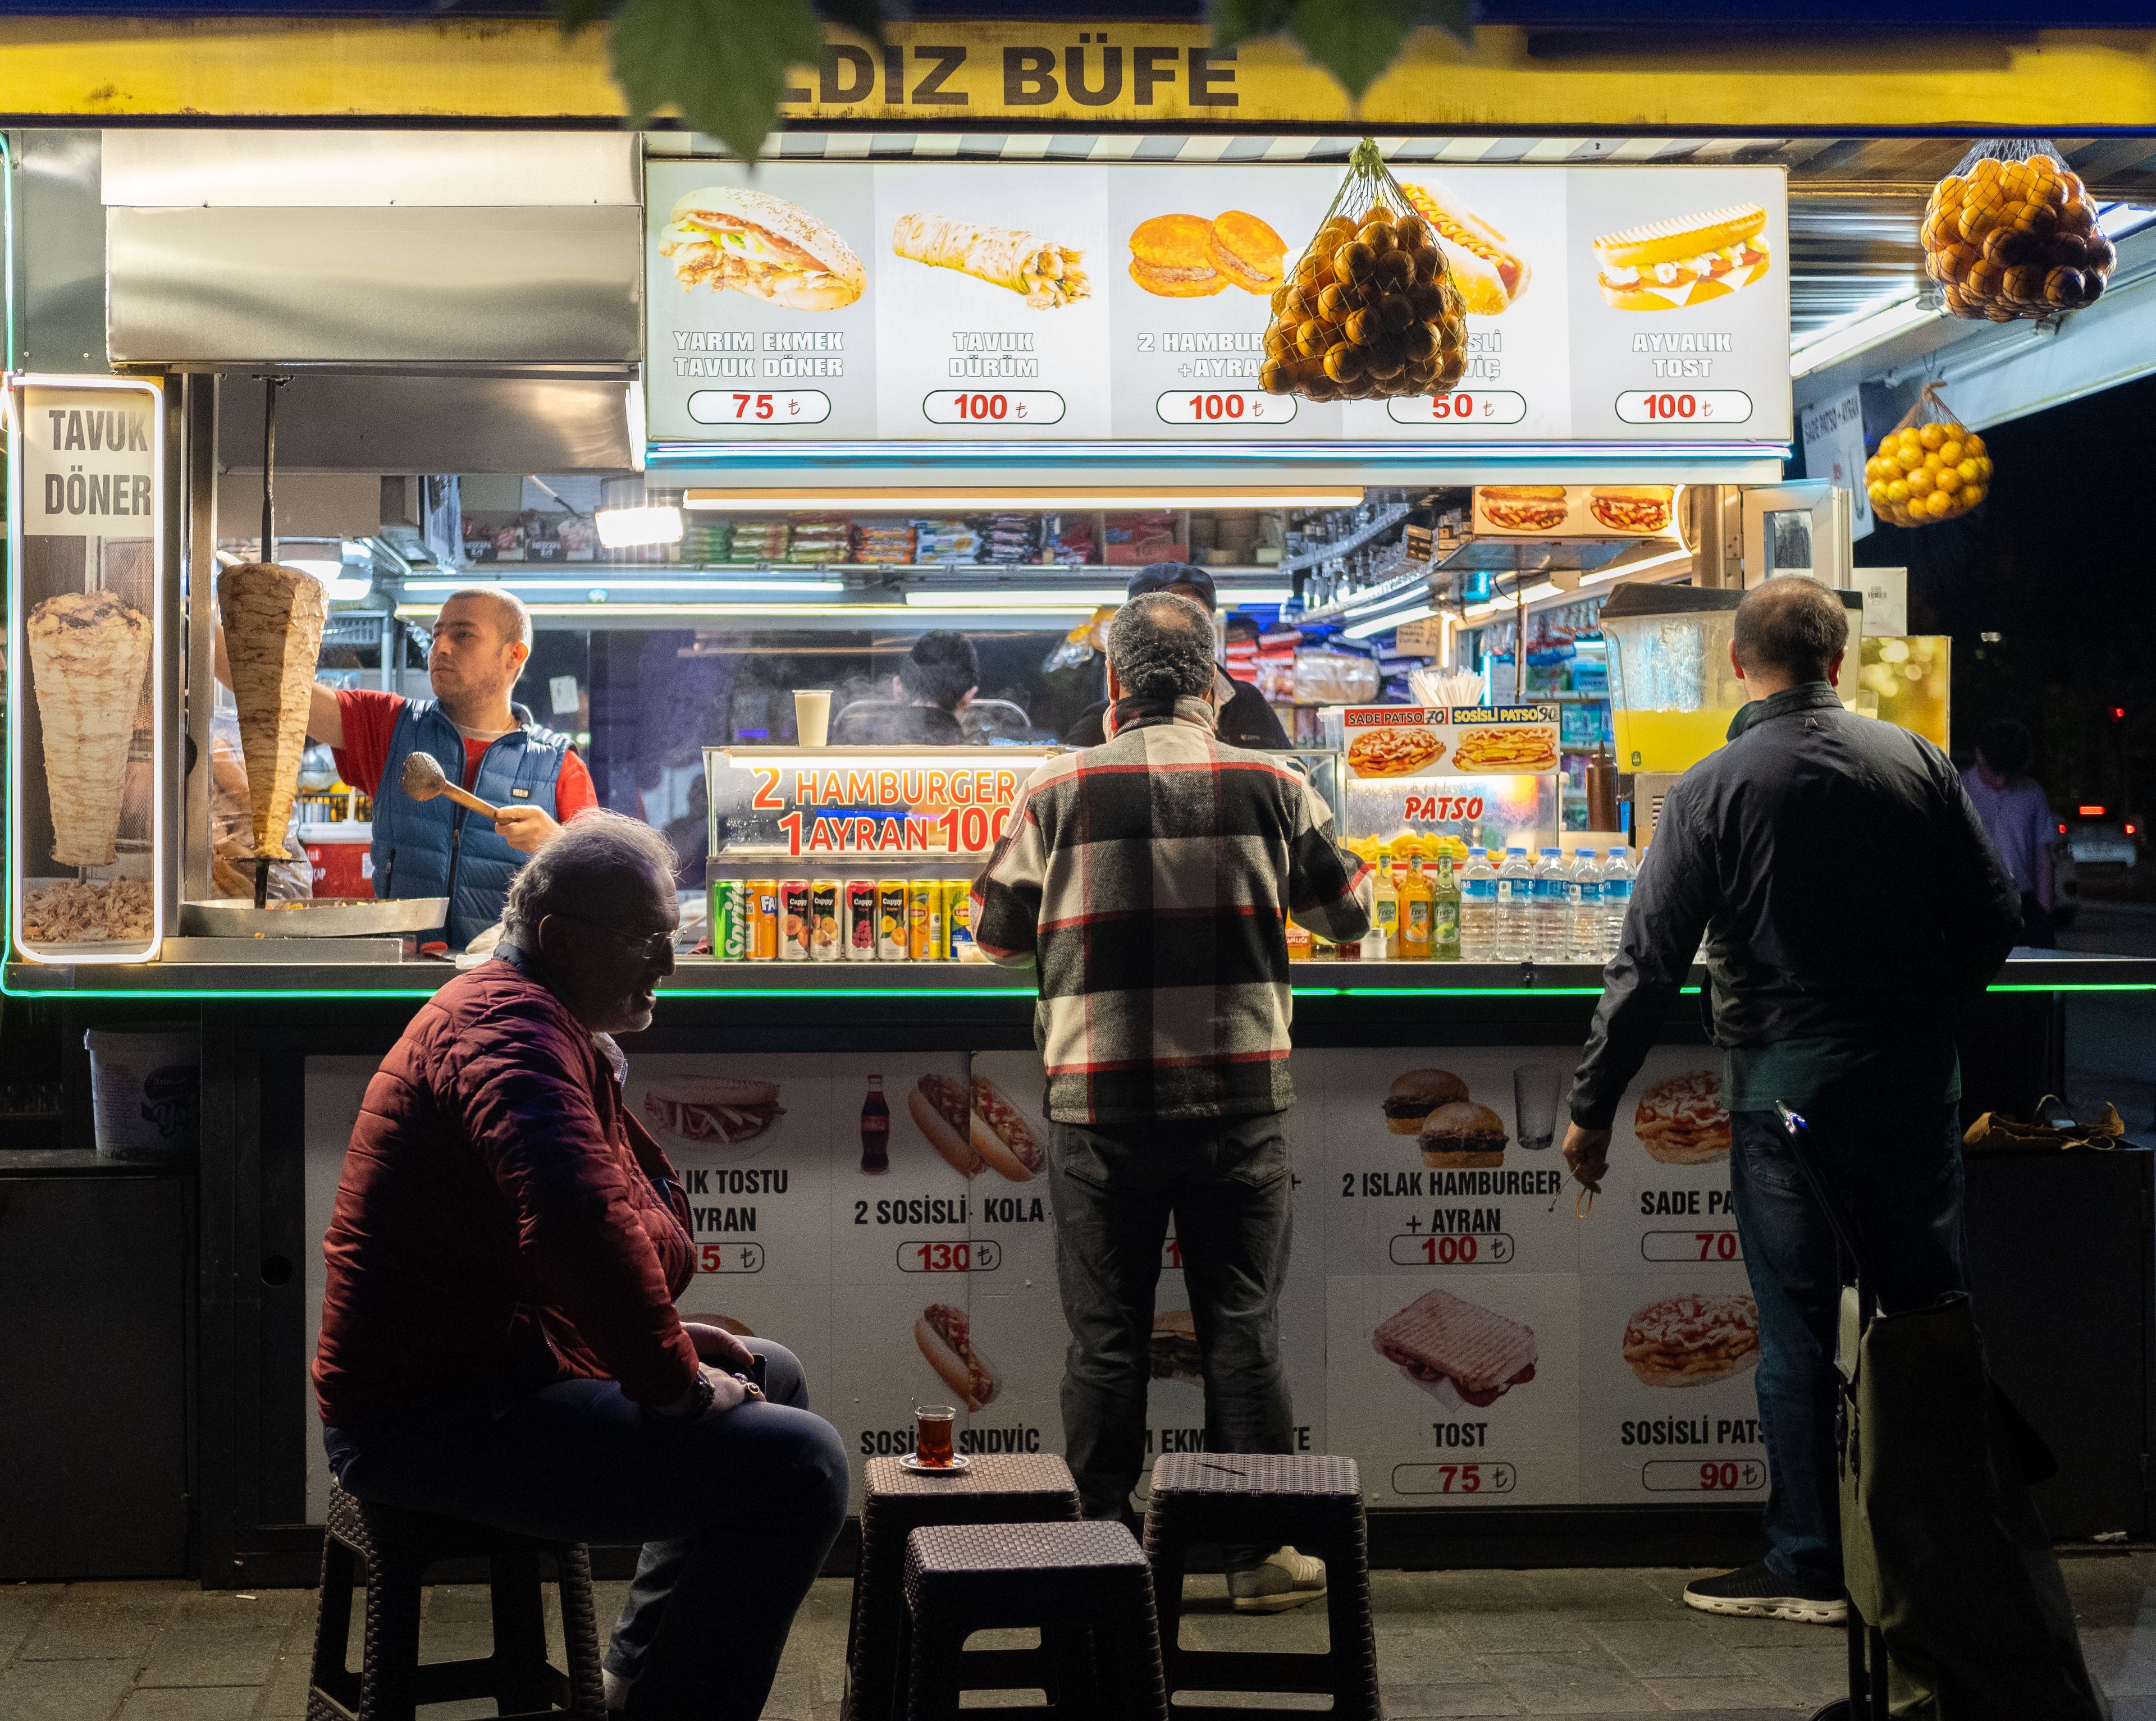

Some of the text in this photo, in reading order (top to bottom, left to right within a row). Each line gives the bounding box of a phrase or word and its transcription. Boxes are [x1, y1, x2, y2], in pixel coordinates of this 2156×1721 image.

[785, 33, 1239, 106] DIZ BÜFE
[673, 331, 843, 351] YARIM EKMEK
[952, 332, 1034, 351] TAVUK
[1138, 333, 1264, 351] 2 HAMBUR
[1467, 329, 1501, 352] SLİ
[1632, 332, 1732, 353] AYVALIK
[674, 355, 843, 377] TAVUK DÖNER
[949, 355, 1038, 377] DÜRÜM
[1178, 358, 1262, 378] +AYRA
[1463, 355, 1500, 381] VİÇ
[1652, 358, 1711, 379] TOST
[732, 394, 774, 419] 75
[954, 394, 1007, 419] 100
[1189, 394, 1244, 419] 100
[1432, 394, 1473, 418] 50
[1643, 393, 1696, 419] 100
[48, 410, 148, 451] TAVUK
[45, 465, 151, 515] DÖNER
[1349, 710, 1445, 724] SADE PATSO 70
[1454, 706, 1557, 722] SOSİSLİ PATSO 90
[751, 768, 1017, 810] 2 HAMBURGER
[1404, 796, 1483, 822] PATSO
[777, 811, 802, 857] 1
[809, 817, 929, 852] AYRAN
[790, 898, 807, 907] Cappy
[815, 898, 833, 906] Cappy
[686, 1169, 788, 1194] IK TOSTU
[1342, 1170, 1561, 1197] 2 ISLAK HAMBURGER
[855, 1194, 1044, 1224] 2 SOSİSLİ KOLA
[1641, 1191, 1700, 1215] SADE
[693, 1207, 756, 1232] YRAN
[1432, 1209, 1501, 1233] AYRAN
[917, 1243, 970, 1271] 130
[1422, 1235, 1477, 1265] 100
[1695, 1233, 1737, 1261] 70
[860, 1425, 920, 1455] SOSİ
[1161, 1429, 1205, 1453] EKM
[1433, 1423, 1487, 1448] TOST
[1621, 1415, 1709, 1445] SOSİSLİ
[1439, 1465, 1480, 1493] 75
[1700, 1462, 1738, 1490] 90
